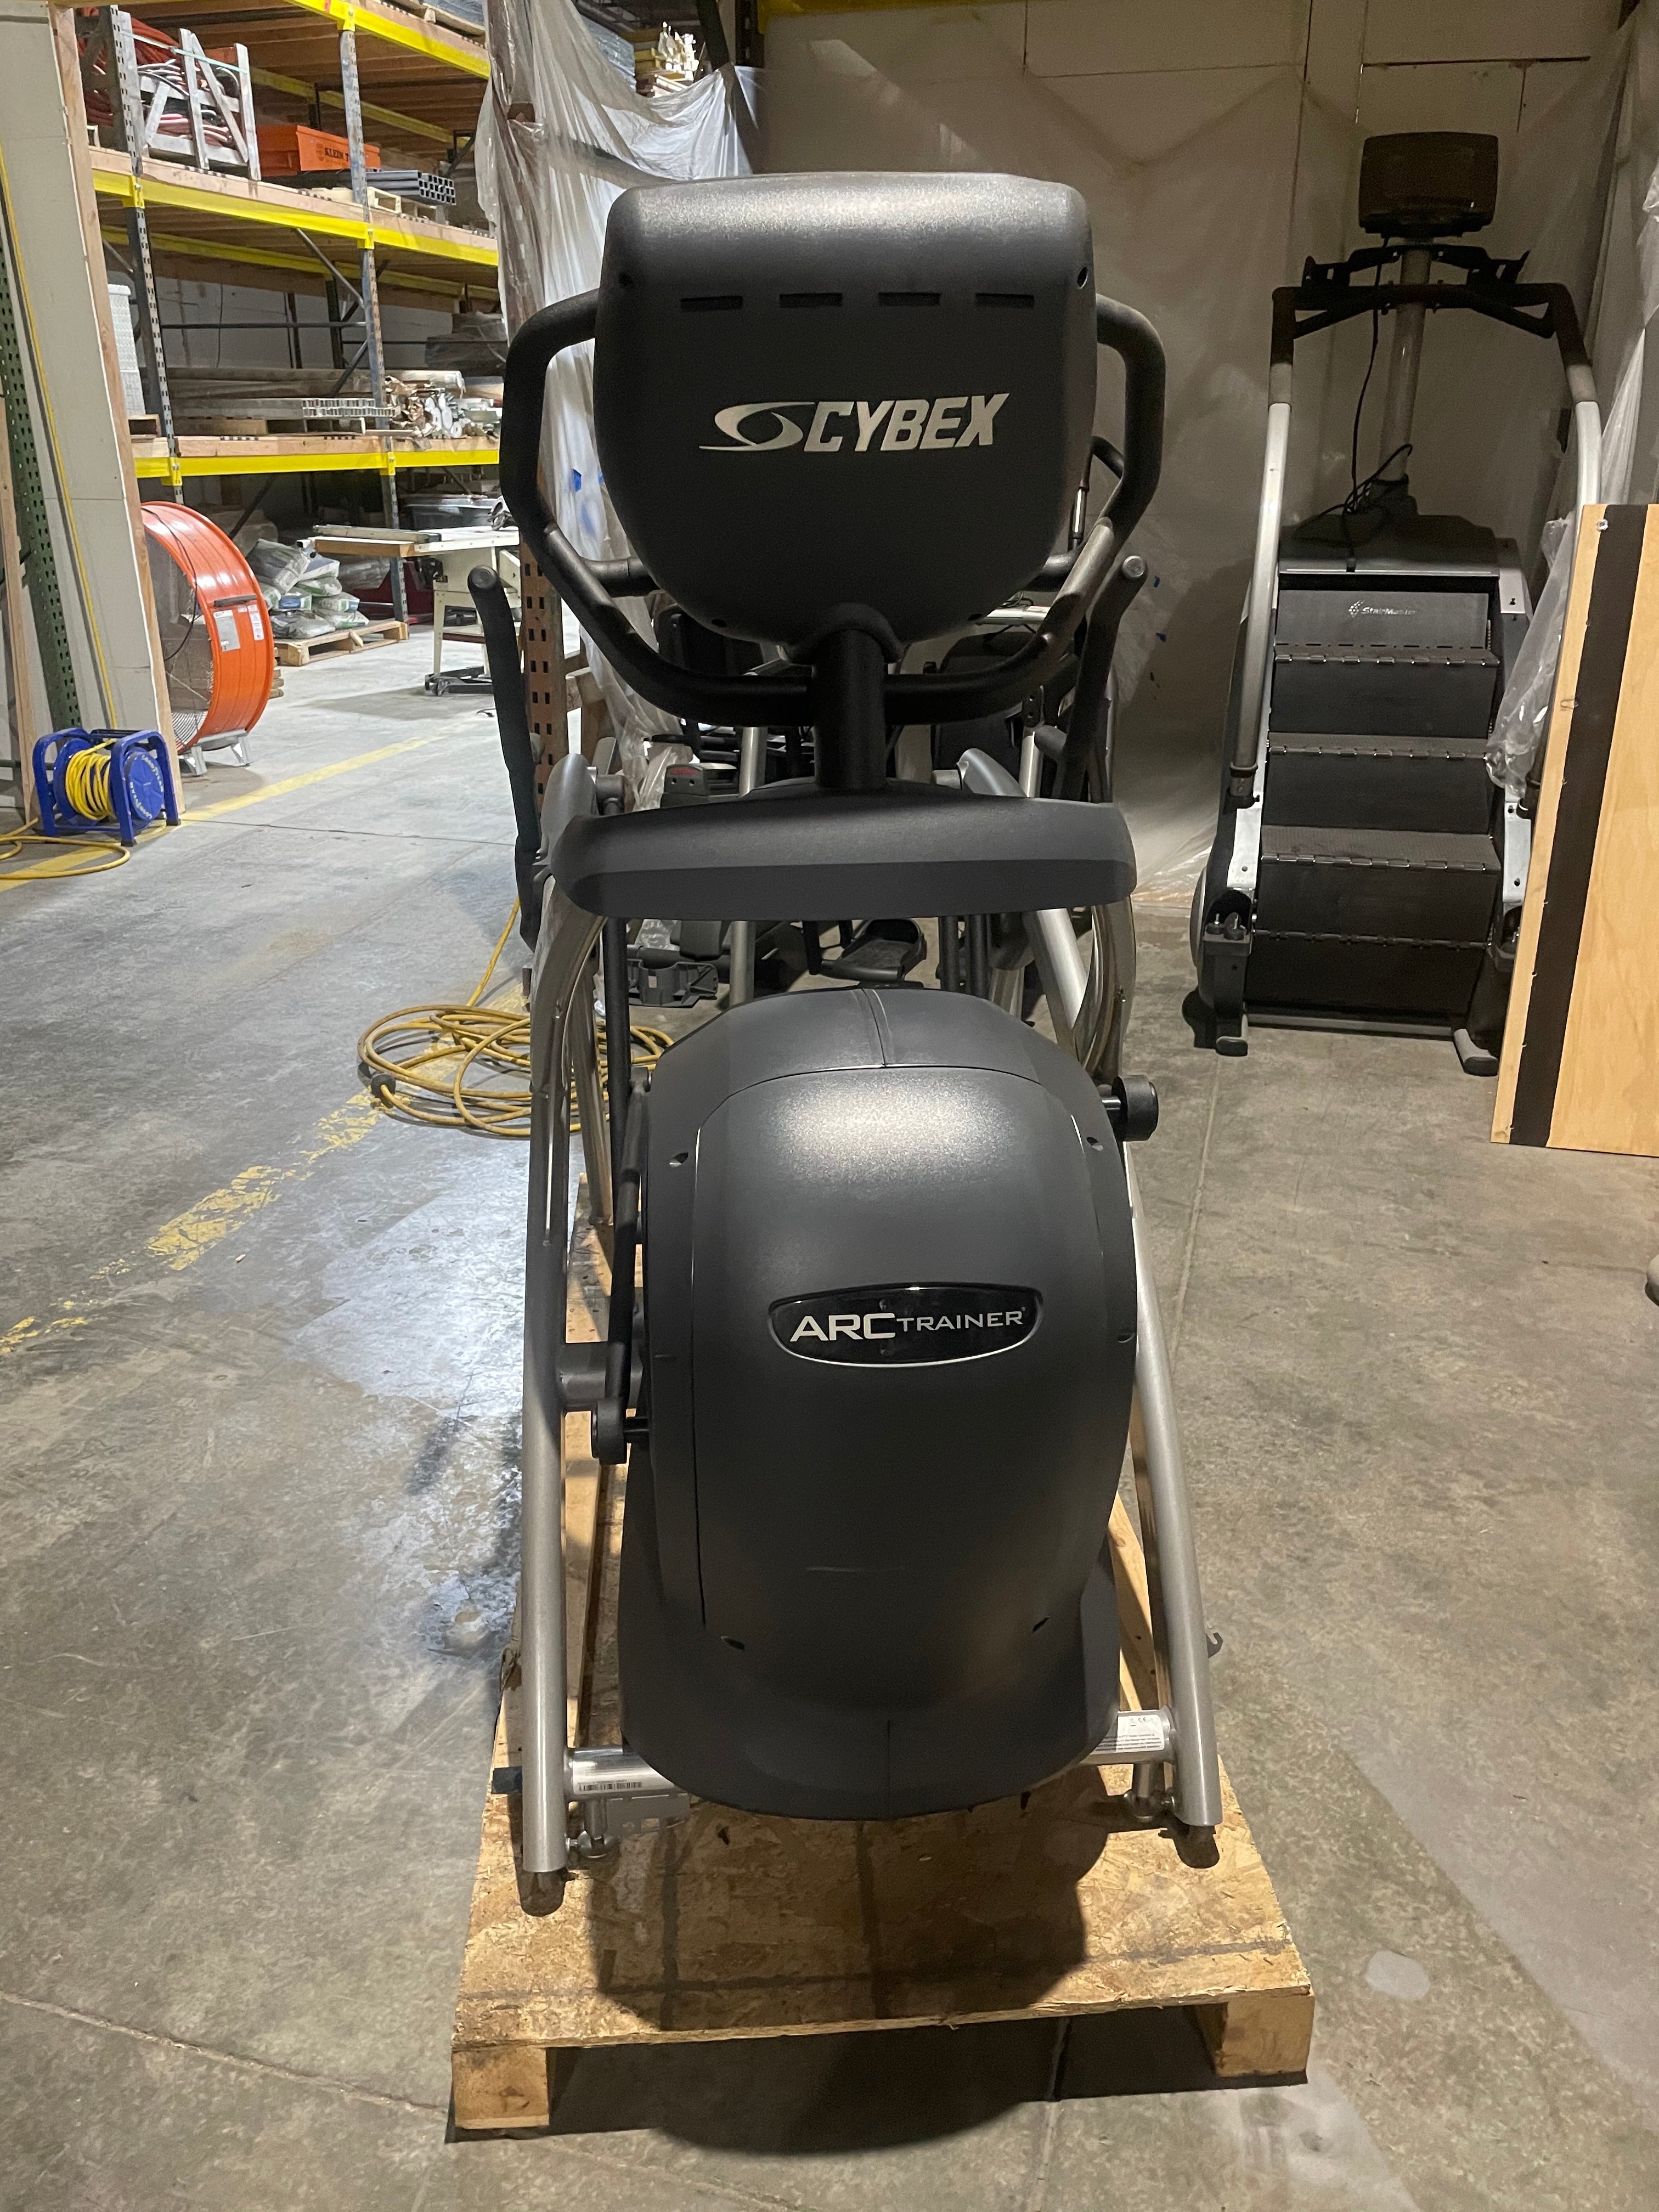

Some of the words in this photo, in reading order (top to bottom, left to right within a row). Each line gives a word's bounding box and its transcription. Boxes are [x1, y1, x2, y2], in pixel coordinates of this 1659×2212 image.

[803, 393, 1010, 452] CYBEX
[789, 1312, 896, 1342] ARC
[896, 1310, 1023, 1332] TRAINER
